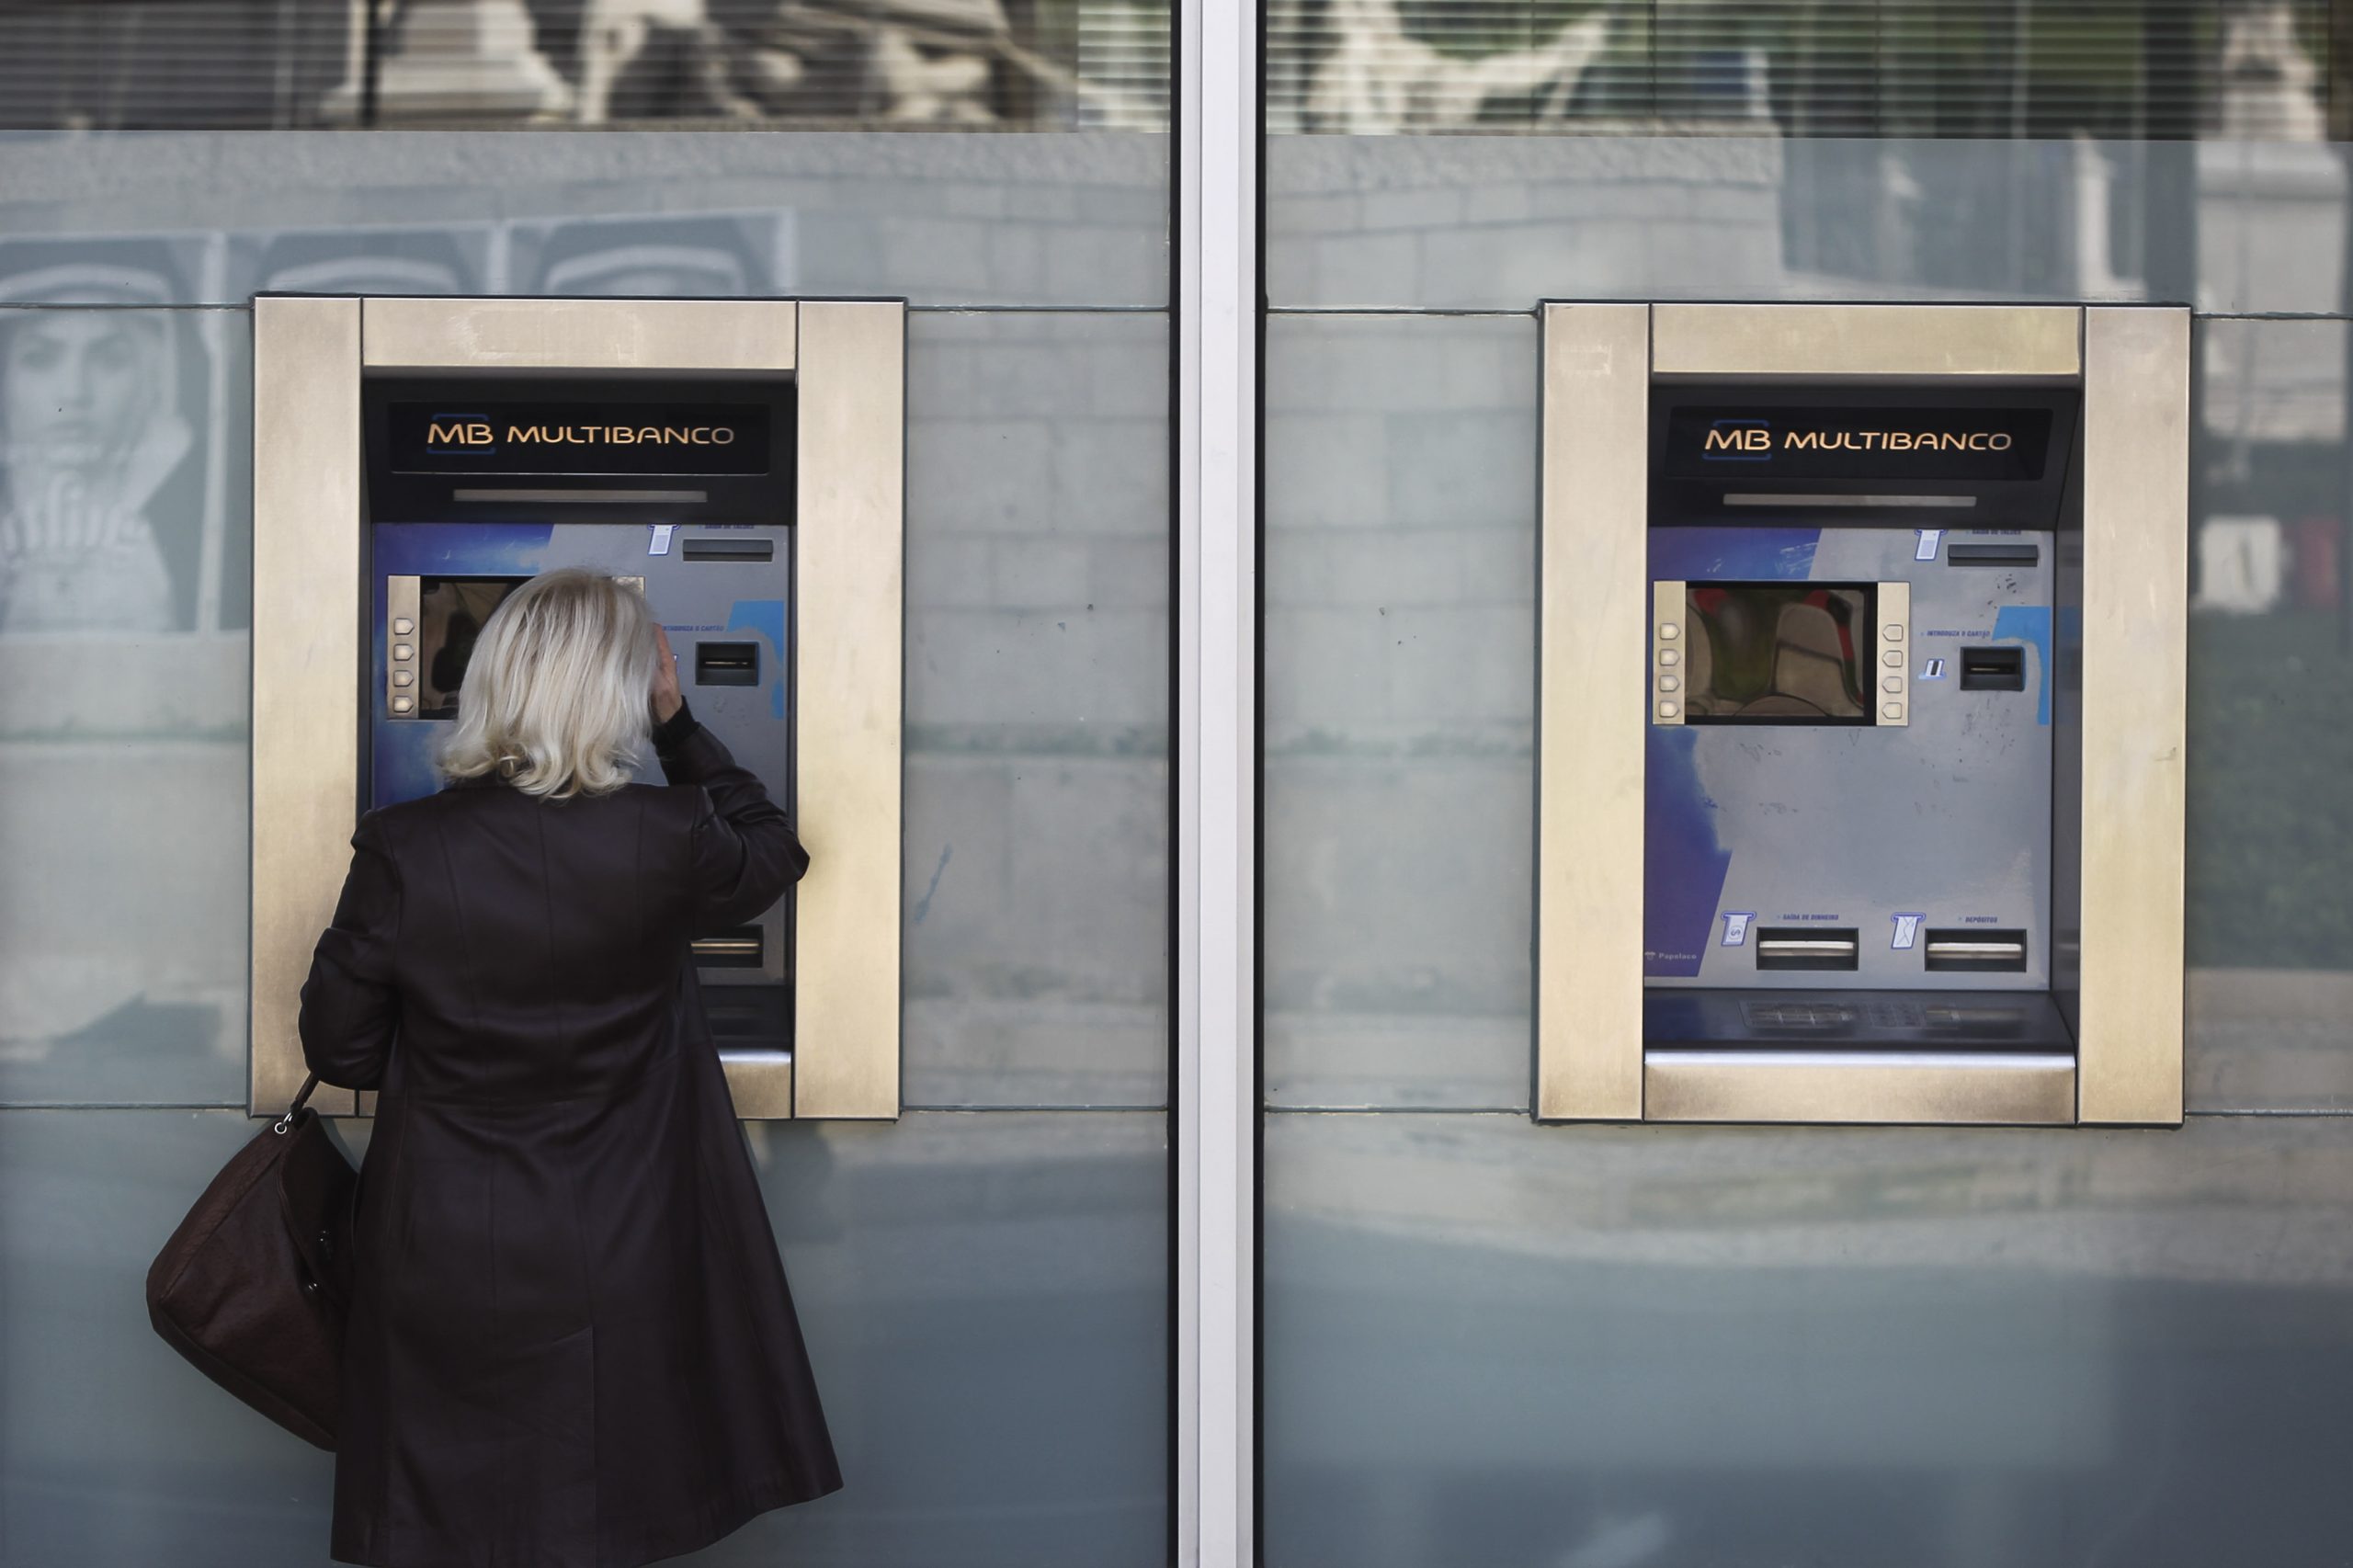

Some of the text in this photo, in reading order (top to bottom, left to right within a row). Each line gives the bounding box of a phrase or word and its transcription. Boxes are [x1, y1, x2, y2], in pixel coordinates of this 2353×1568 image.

[427, 423, 734, 445] MB MULTIBANCO
[1704, 429, 2012, 450] MB MULTIBANCO
